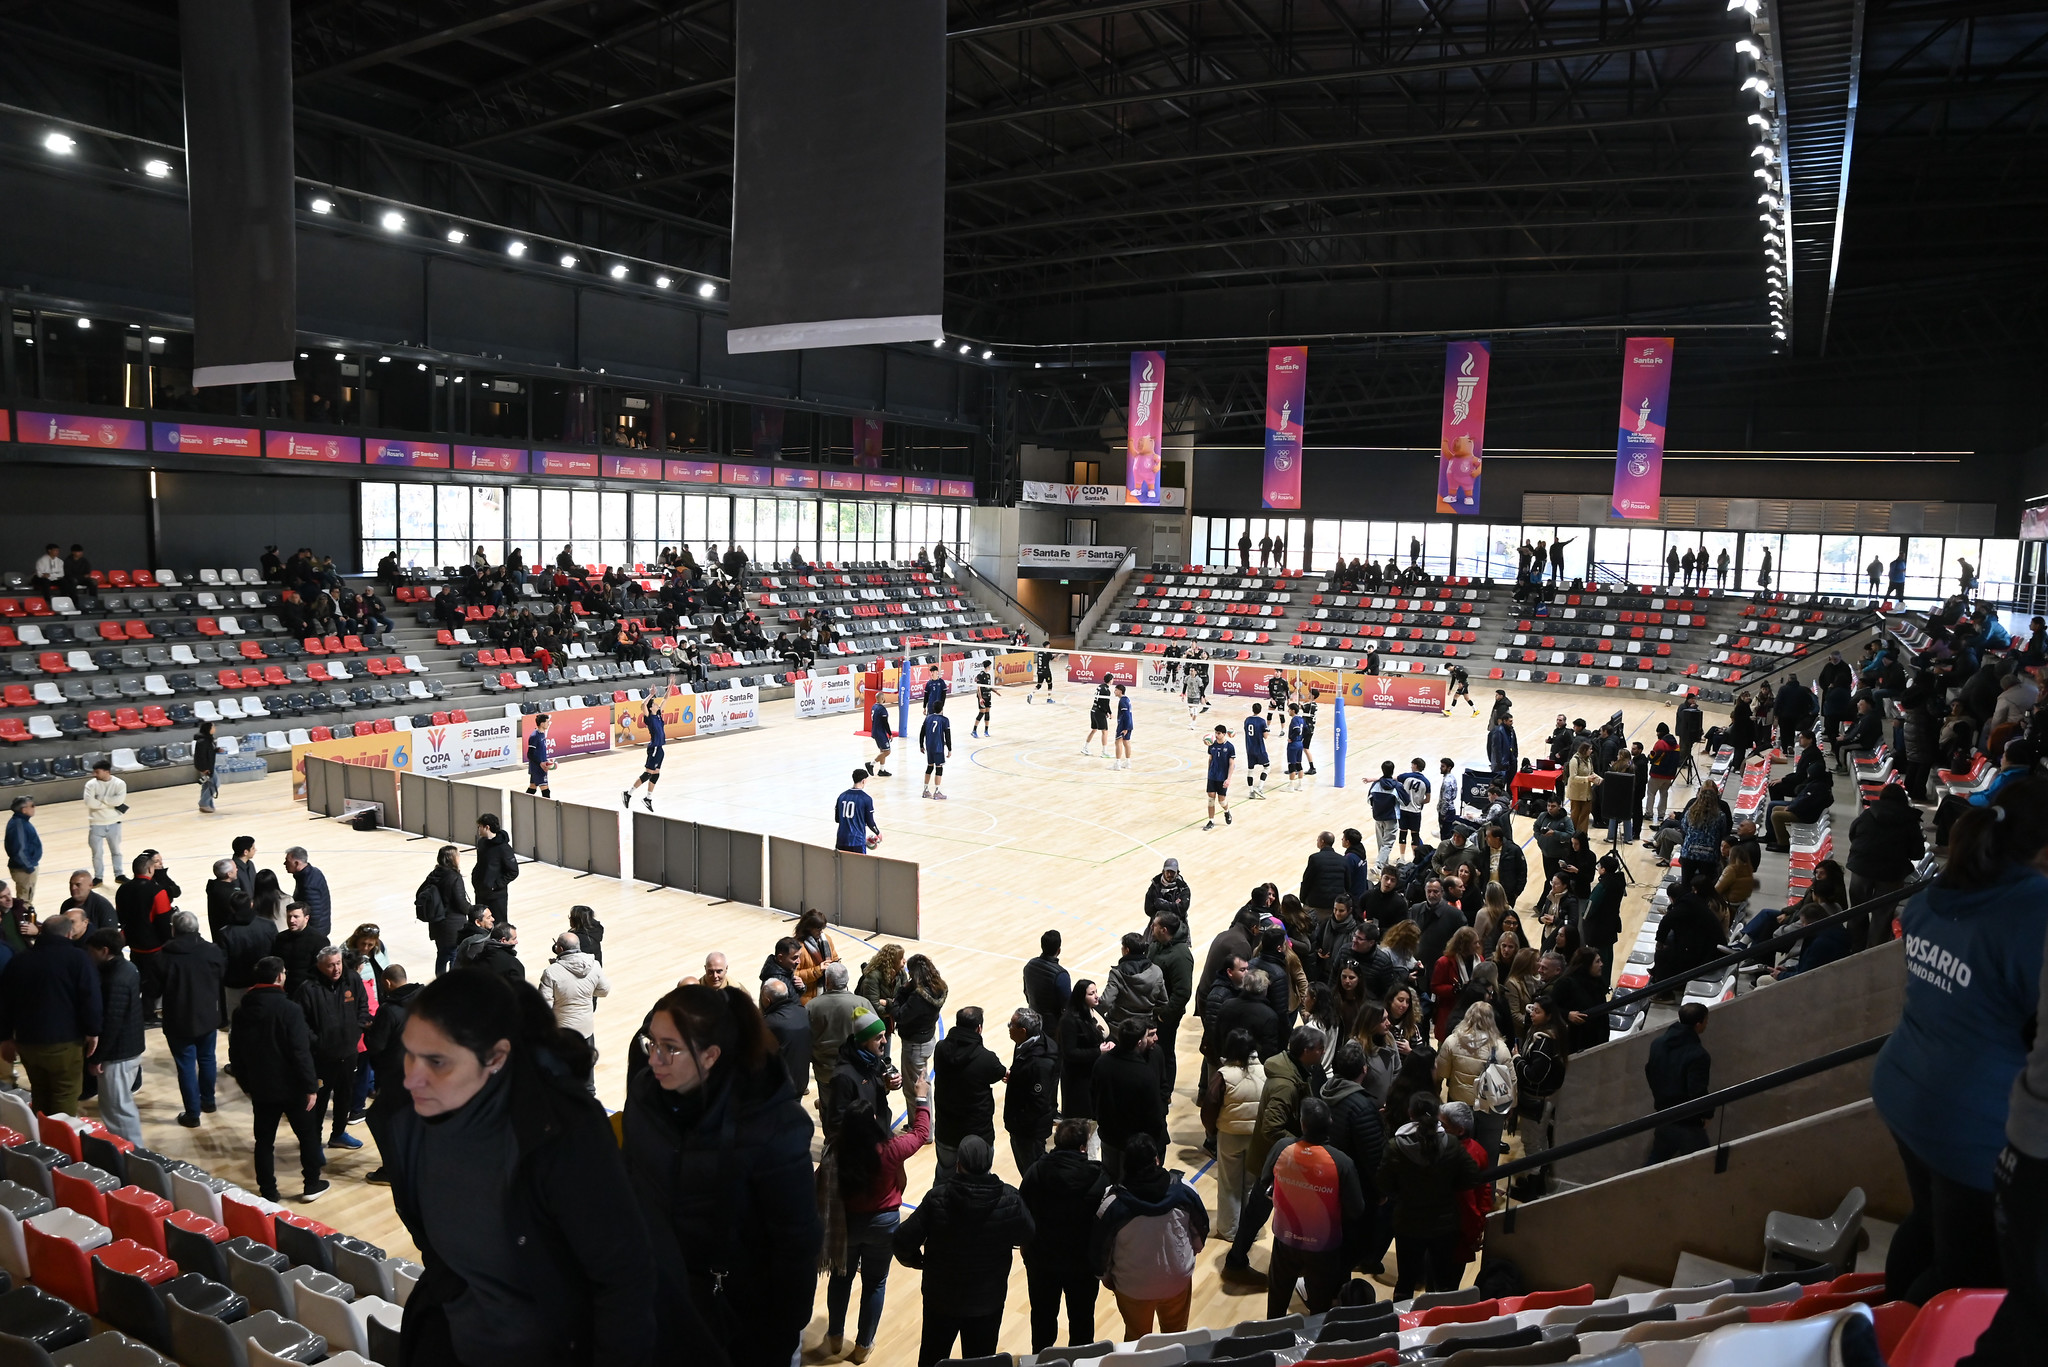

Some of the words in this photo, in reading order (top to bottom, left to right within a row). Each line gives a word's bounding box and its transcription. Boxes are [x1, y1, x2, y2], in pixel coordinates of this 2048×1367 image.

[180, 436, 203, 445] Rosario
[1081, 486, 1109, 496] COPA
[1033, 548, 1059, 557] Santa
[1060, 549, 1071, 558] Fe
[1087, 550, 1113, 559] Santa
[1114, 550, 1124, 559] Fe
[1004, 660, 1026, 675] Quini
[1026, 660, 1033, 673] 6
[1124, 672, 1133, 680] Fe
[828, 680, 843, 688] Santa
[843, 679, 850, 687] Fe
[911, 683, 924, 691] COPA
[1222, 681, 1242, 689] COPA
[1352, 682, 1363, 697] 6
[728, 693, 746, 702] Santa
[747, 692, 754, 701] Fe
[799, 699, 816, 707] COPA
[829, 696, 844, 705] Quini
[845, 694, 851, 703] 6
[1372, 694, 1394, 702] COPA
[1407, 696, 1431, 705] Santa
[1431, 698, 1440, 706] Fe
[682, 705, 694, 724] 6
[697, 713, 715, 724] COPA
[729, 711, 748, 721] Quini
[748, 709, 754, 719] 6
[473, 727, 499, 737] Santa
[500, 725, 510, 735] Fe
[932, 720, 938, 733] 7
[1247, 724, 1254, 736] 9
[570, 732, 595, 744] Santa
[596, 730, 606, 741] Fe
[392, 745, 409, 768] 6
[474, 746, 501, 760] Quini
[503, 744, 511, 756] 6
[422, 752, 451, 765] COPA
[1408, 779, 1421, 793] 14
[841, 800, 855, 819] 10
[1905, 934, 1972, 988] ROSARIO
[1907, 959, 1953, 994] HANDBALL
